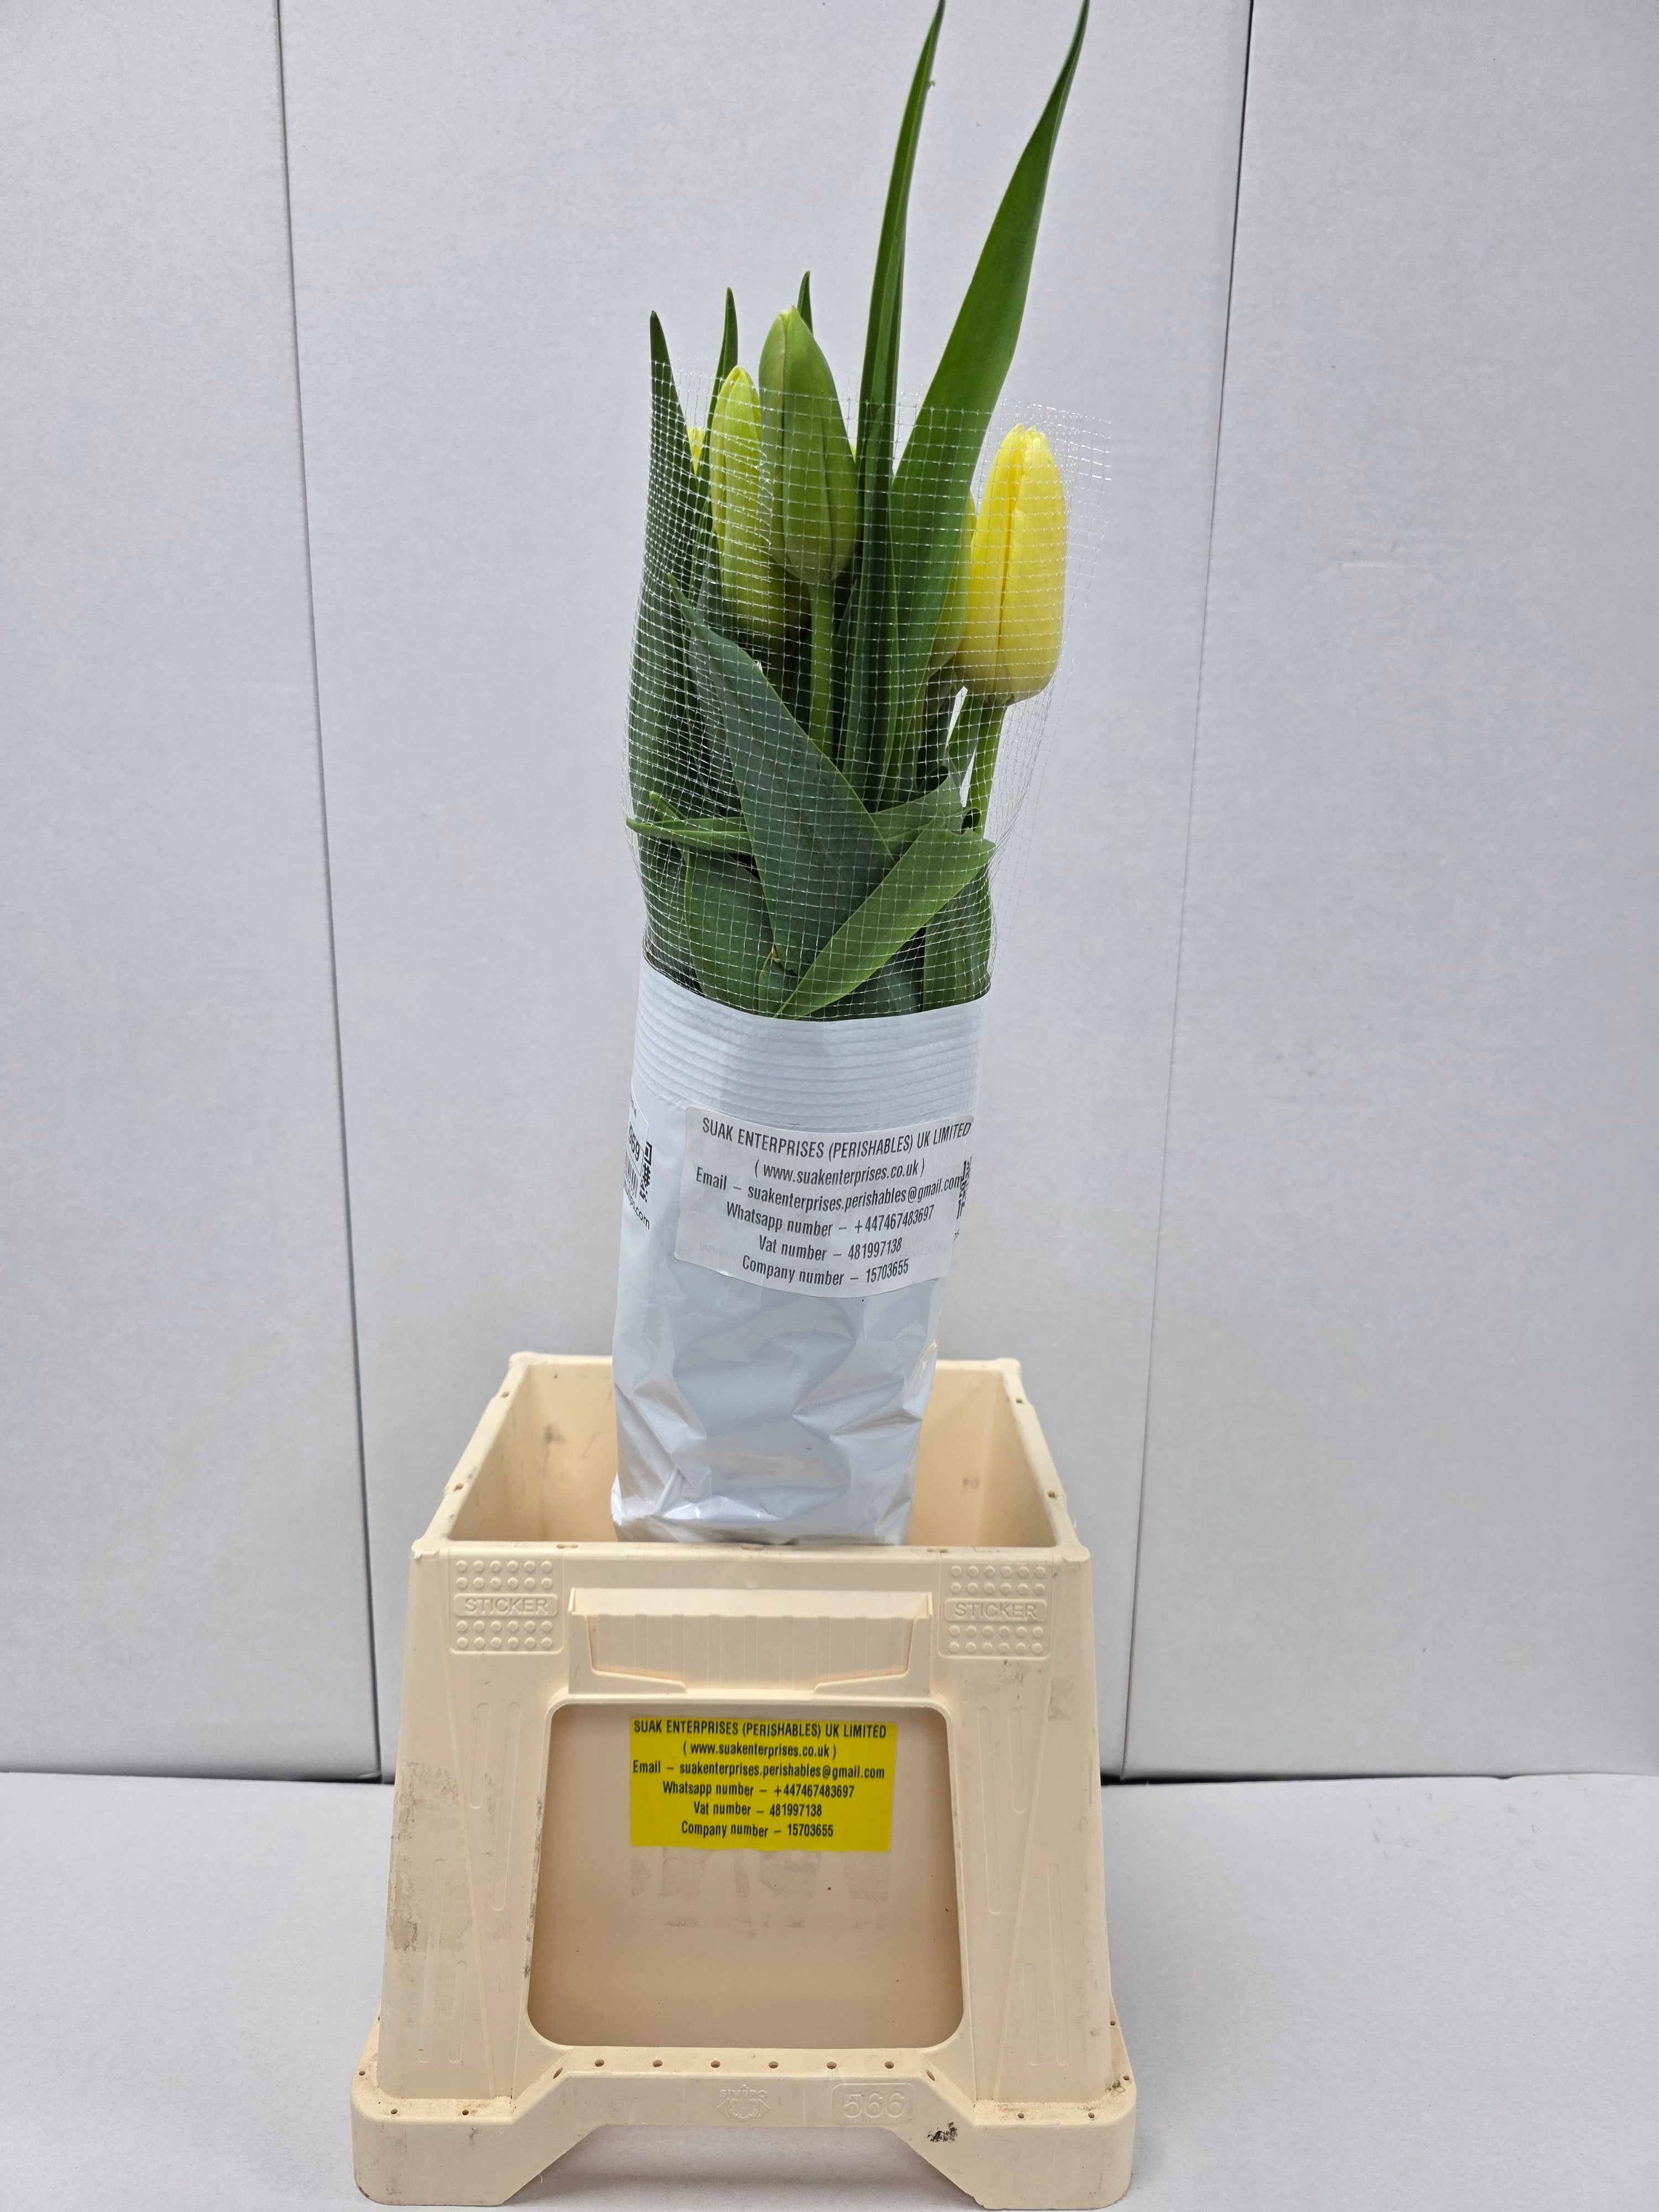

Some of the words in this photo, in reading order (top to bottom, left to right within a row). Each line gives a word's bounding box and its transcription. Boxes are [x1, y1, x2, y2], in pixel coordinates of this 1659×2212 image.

[702, 1117, 734, 1142] SUAK
[738, 1128, 825, 1159] ENTERPRISES
[828, 1134, 913, 1162] (PERISHABLES)
[916, 1130, 931, 1149] UK
[932, 1121, 972, 1146] LIMITED
[763, 1159, 919, 1187] www.suakenterprises.co.uk
[696, 1166, 727, 1191] Email
[747, 1174, 964, 1214] suakenterprises.perishables@gmail.com
[727, 1201, 783, 1233] Whatsapp
[786, 1220, 833, 1238] number
[759, 1234, 778, 1254] Vat
[780, 1243, 828, 1261] number
[847, 1237, 902, 1260] 481997138
[742, 1255, 796, 1284] Company
[799, 1270, 845, 1286] number
[865, 1258, 909, 1284] 15703655
[465, 1597, 549, 1615] STICKER
[954, 1603, 1037, 1620] STICKER
[634, 1719, 662, 1733] SUAK
[666, 1719, 739, 1735] ENTERPRISES
[742, 1721, 821, 1739] (PERISHABLES)
[825, 1723, 839, 1738] UK
[843, 1724, 886, 1739] LIMITED
[690, 1741, 830, 1760] www.suakenterprises.co.uk
[633, 1759, 661, 1774] Email
[679, 1761, 885, 1781] suakenterprises.perishables@gmail.com
[662, 1780, 712, 1798] Whatsapp
[716, 1781, 754, 1797] number
[693, 1800, 709, 1816] Vat
[713, 1801, 752, 1817] number
[769, 1803, 822, 1818] 481997138
[681, 1820, 727, 1839] Company
[731, 1823, 769, 1838] number
[787, 1823, 834, 1838] 15703655
[842, 2090, 905, 2118] 566
